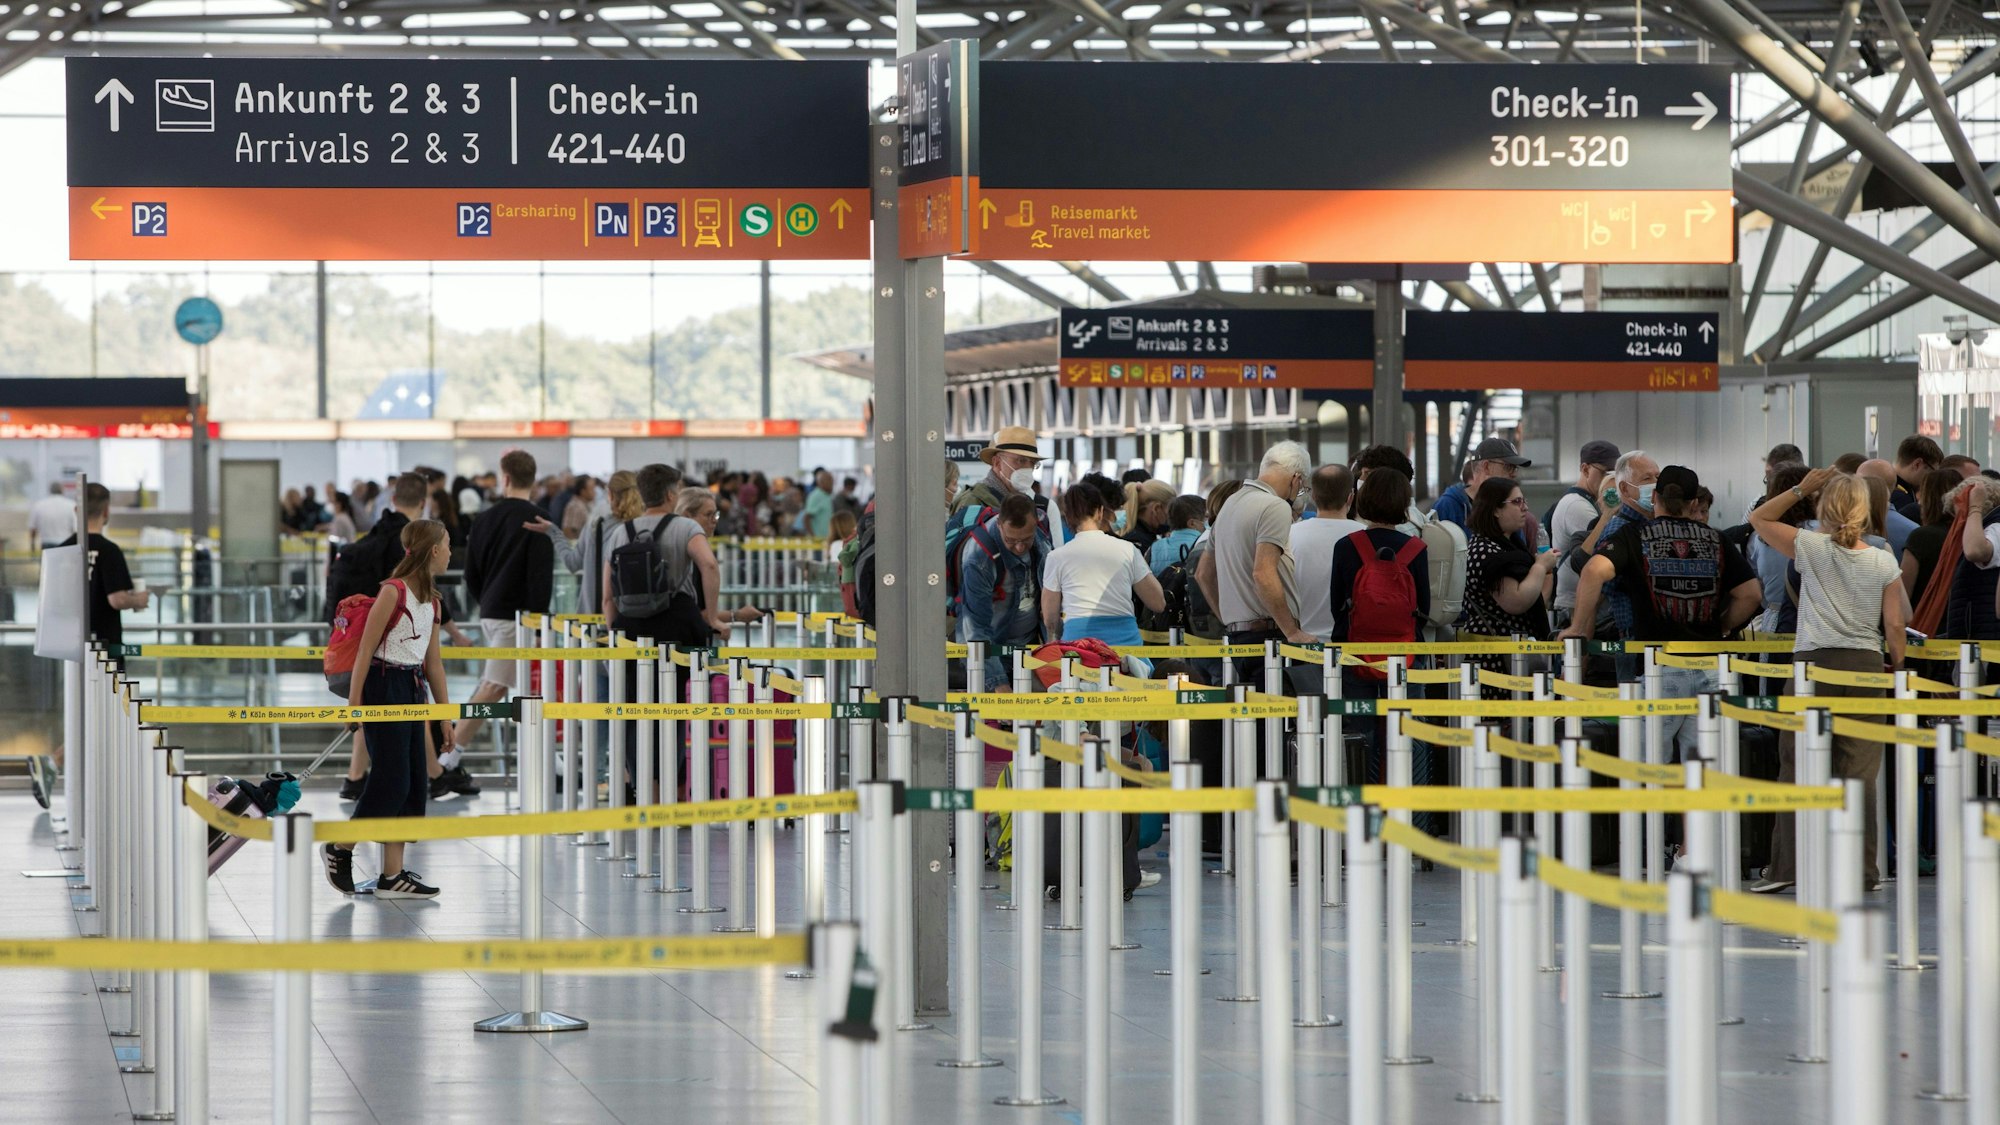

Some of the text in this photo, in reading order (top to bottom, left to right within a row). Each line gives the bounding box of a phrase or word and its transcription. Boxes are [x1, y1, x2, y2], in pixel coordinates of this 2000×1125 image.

[235, 83, 480, 114] Ankunft 2 & 3
[549, 83, 697, 114] Check-in
[1491, 87, 1638, 118] Check-in
[235, 132, 480, 163] Arrivals 2 & 3
[548, 133, 685, 163] 421-440
[1490, 136, 1629, 167] 301-320
[496, 204, 577, 220] Carsharing
[1051, 205, 1138, 220] Reisemarkt
[1561, 202, 1583, 216] WC
[1608, 207, 1631, 221] WC
[1051, 224, 1151, 239] Travel market
[1136, 319, 1229, 332] Ankunft 2 & 3
[1626, 321, 1687, 336] Check-in
[1136, 338, 1229, 351] Arrivals 2 & 3
[1626, 342, 1682, 356] 421-440
[1016, 697, 1041, 705] Airport
[1122, 695, 1148, 703] Airport
[288, 711, 315, 719] Airport
[403, 709, 430, 717] Airport
[663, 708, 689, 716] Airport
